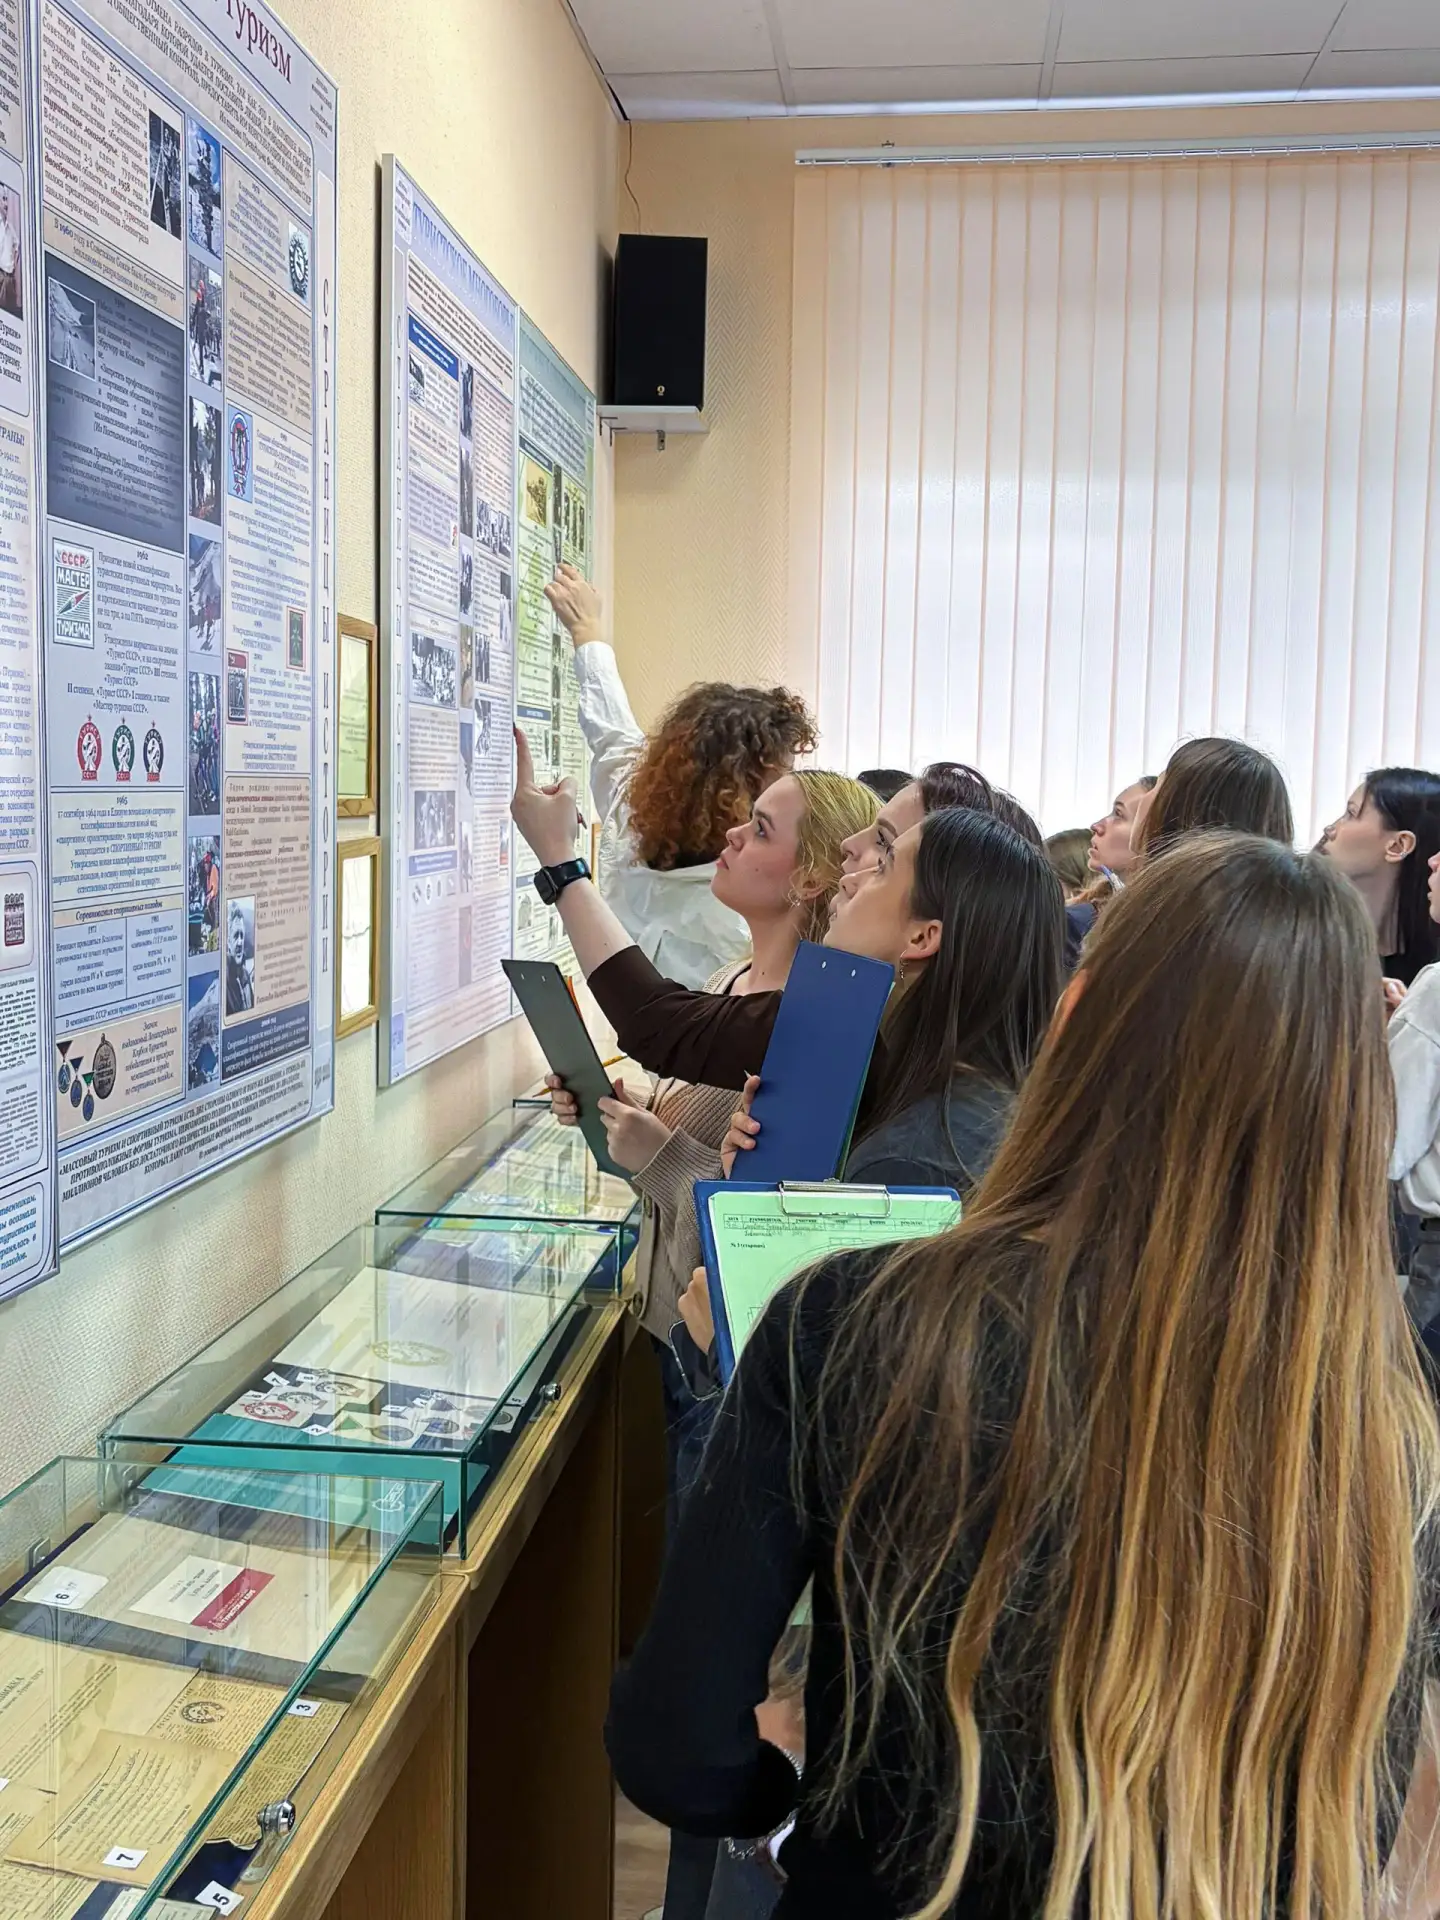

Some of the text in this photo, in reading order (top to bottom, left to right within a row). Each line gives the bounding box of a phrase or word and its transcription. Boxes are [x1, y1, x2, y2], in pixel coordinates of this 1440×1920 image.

[61, 551, 86, 567] СССР
[57, 566, 90, 589] МАСТЕР
[99, 1141, 120, 1158] ТУРИЗМ
[116, 1853, 134, 1861] 7
[212, 1892, 230, 1906] 5
